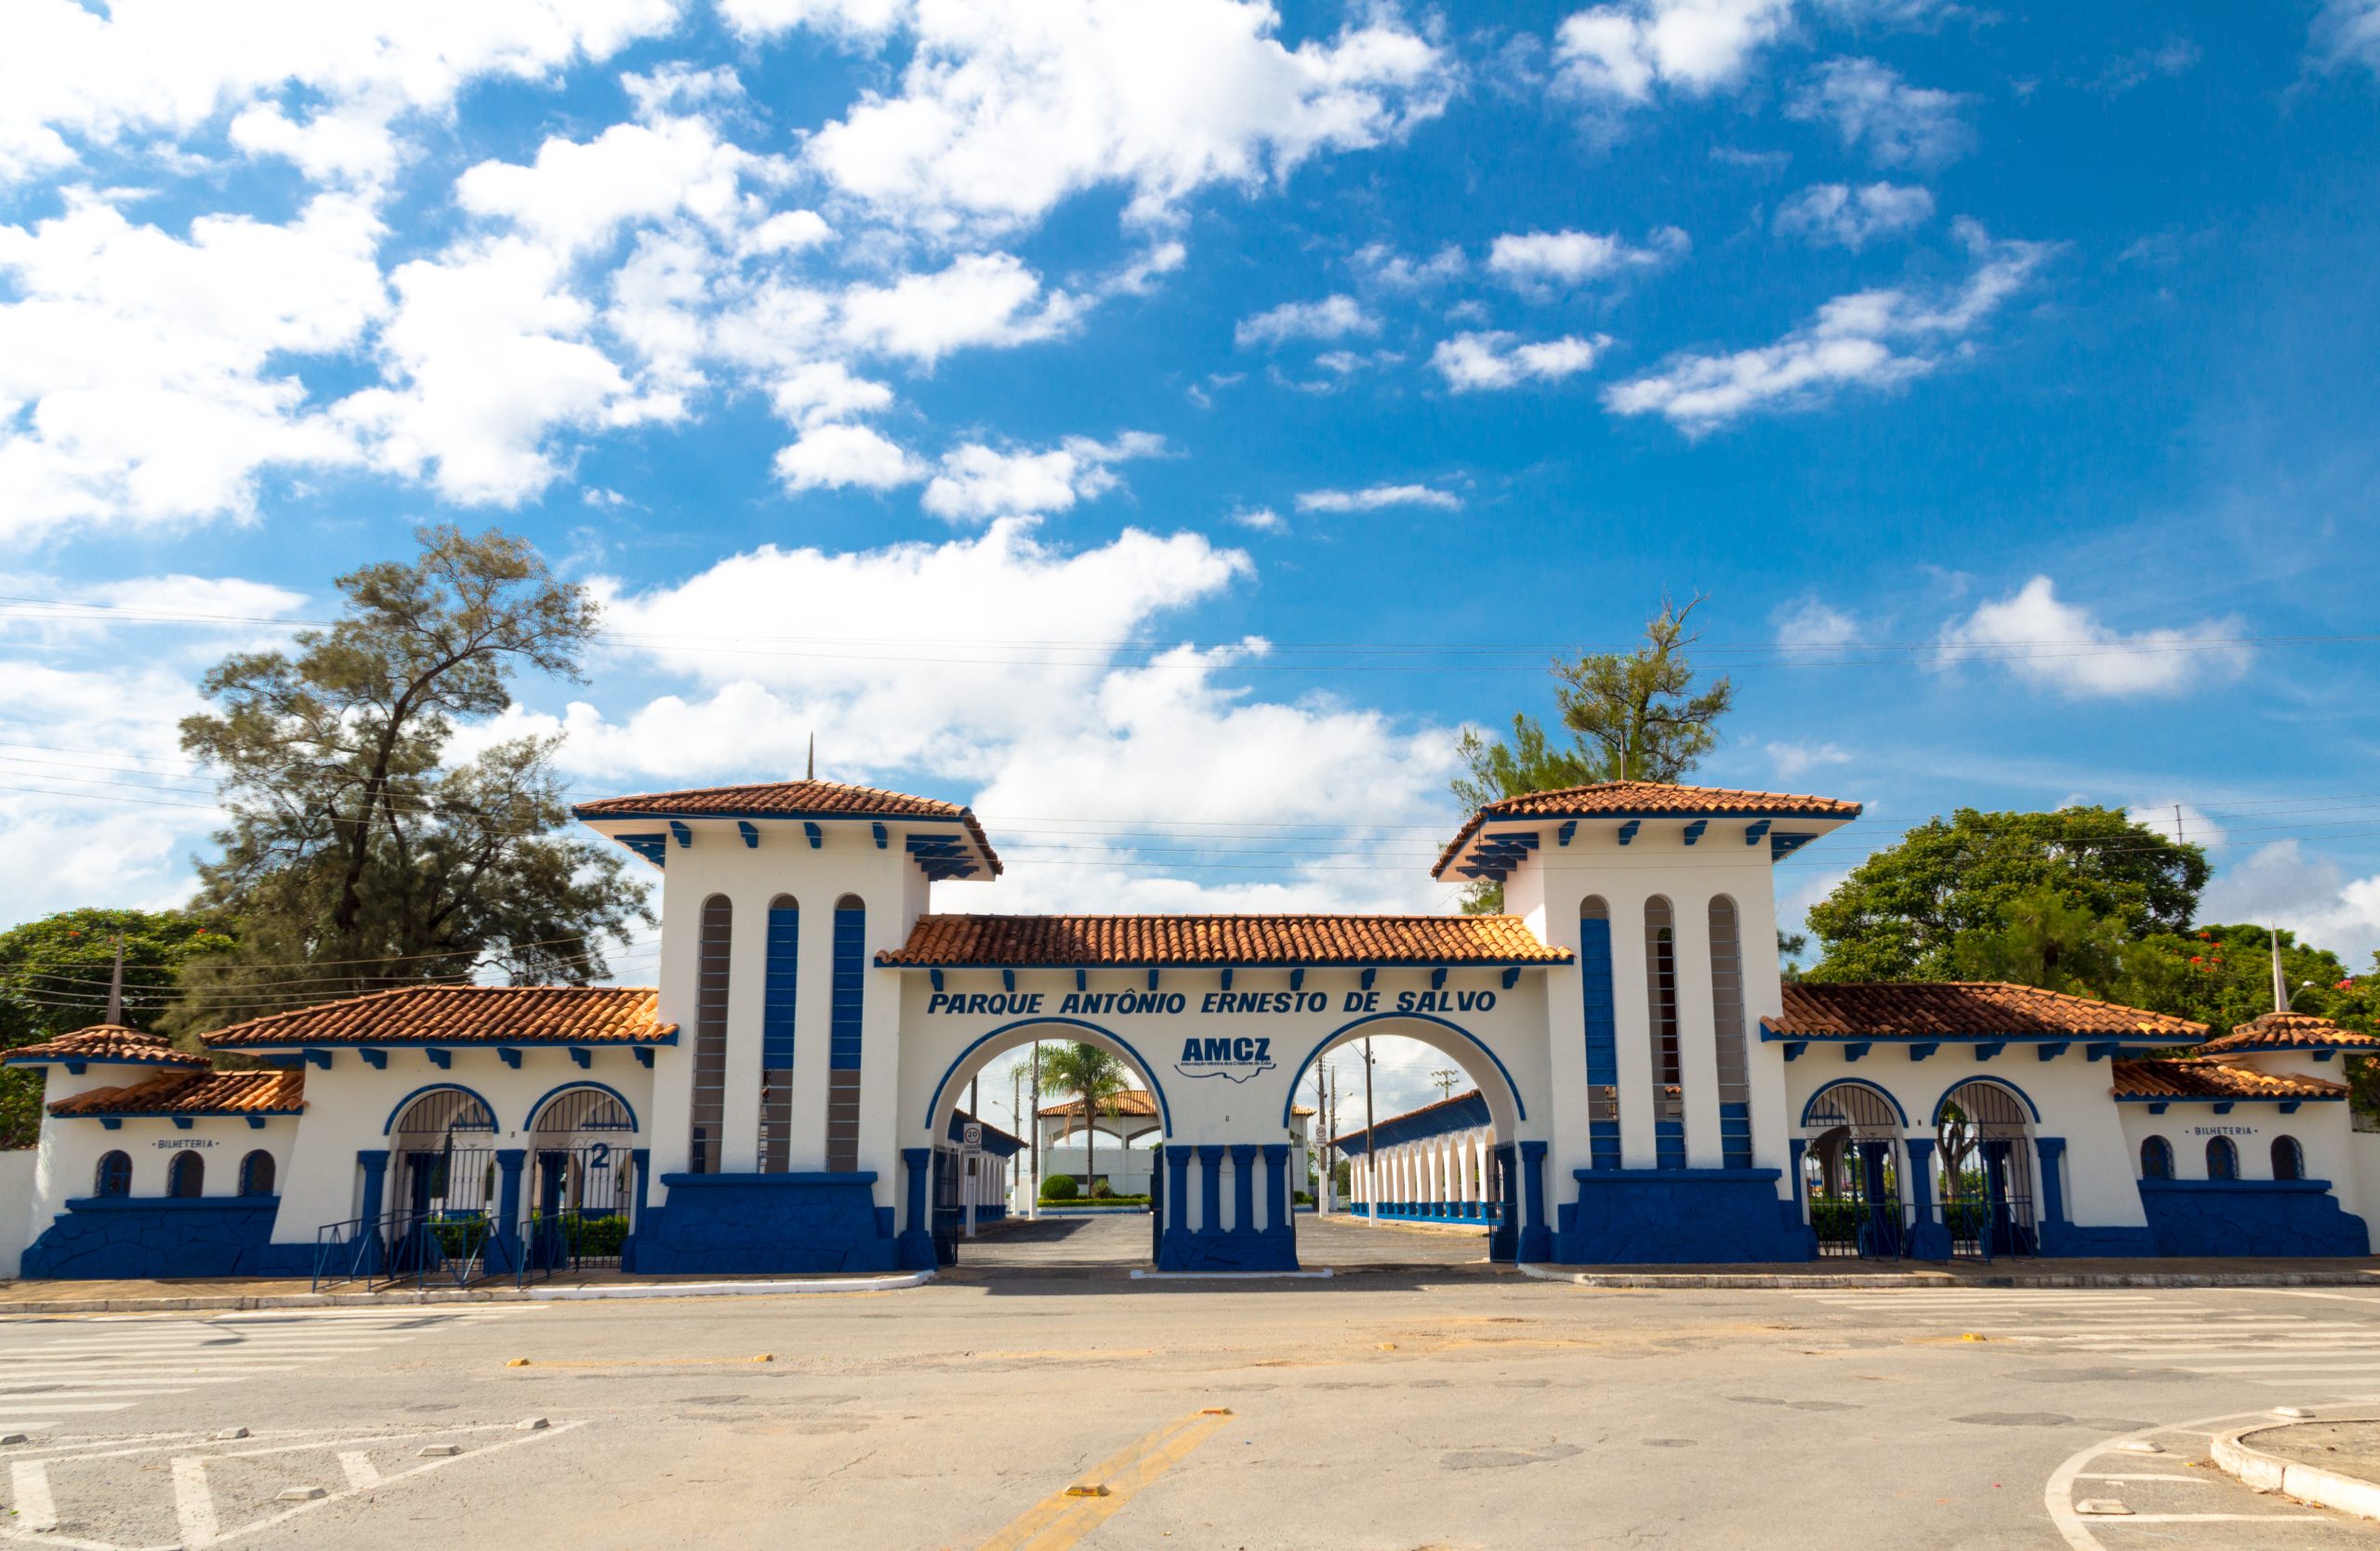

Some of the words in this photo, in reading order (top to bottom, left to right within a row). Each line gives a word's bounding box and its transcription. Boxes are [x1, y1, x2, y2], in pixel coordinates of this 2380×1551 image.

[928, 993, 1045, 1015] PARQUE
[1059, 988, 1186, 1014] ANTÔNIO
[1200, 991, 1328, 1014] ERNESTO
[1343, 991, 1381, 1013] DE
[1396, 990, 1496, 1013] SALVO
[1182, 1038, 1271, 1061] AMCZ
[158, 1139, 213, 1148] BILHETERIA
[590, 1143, 610, 1168] 2
